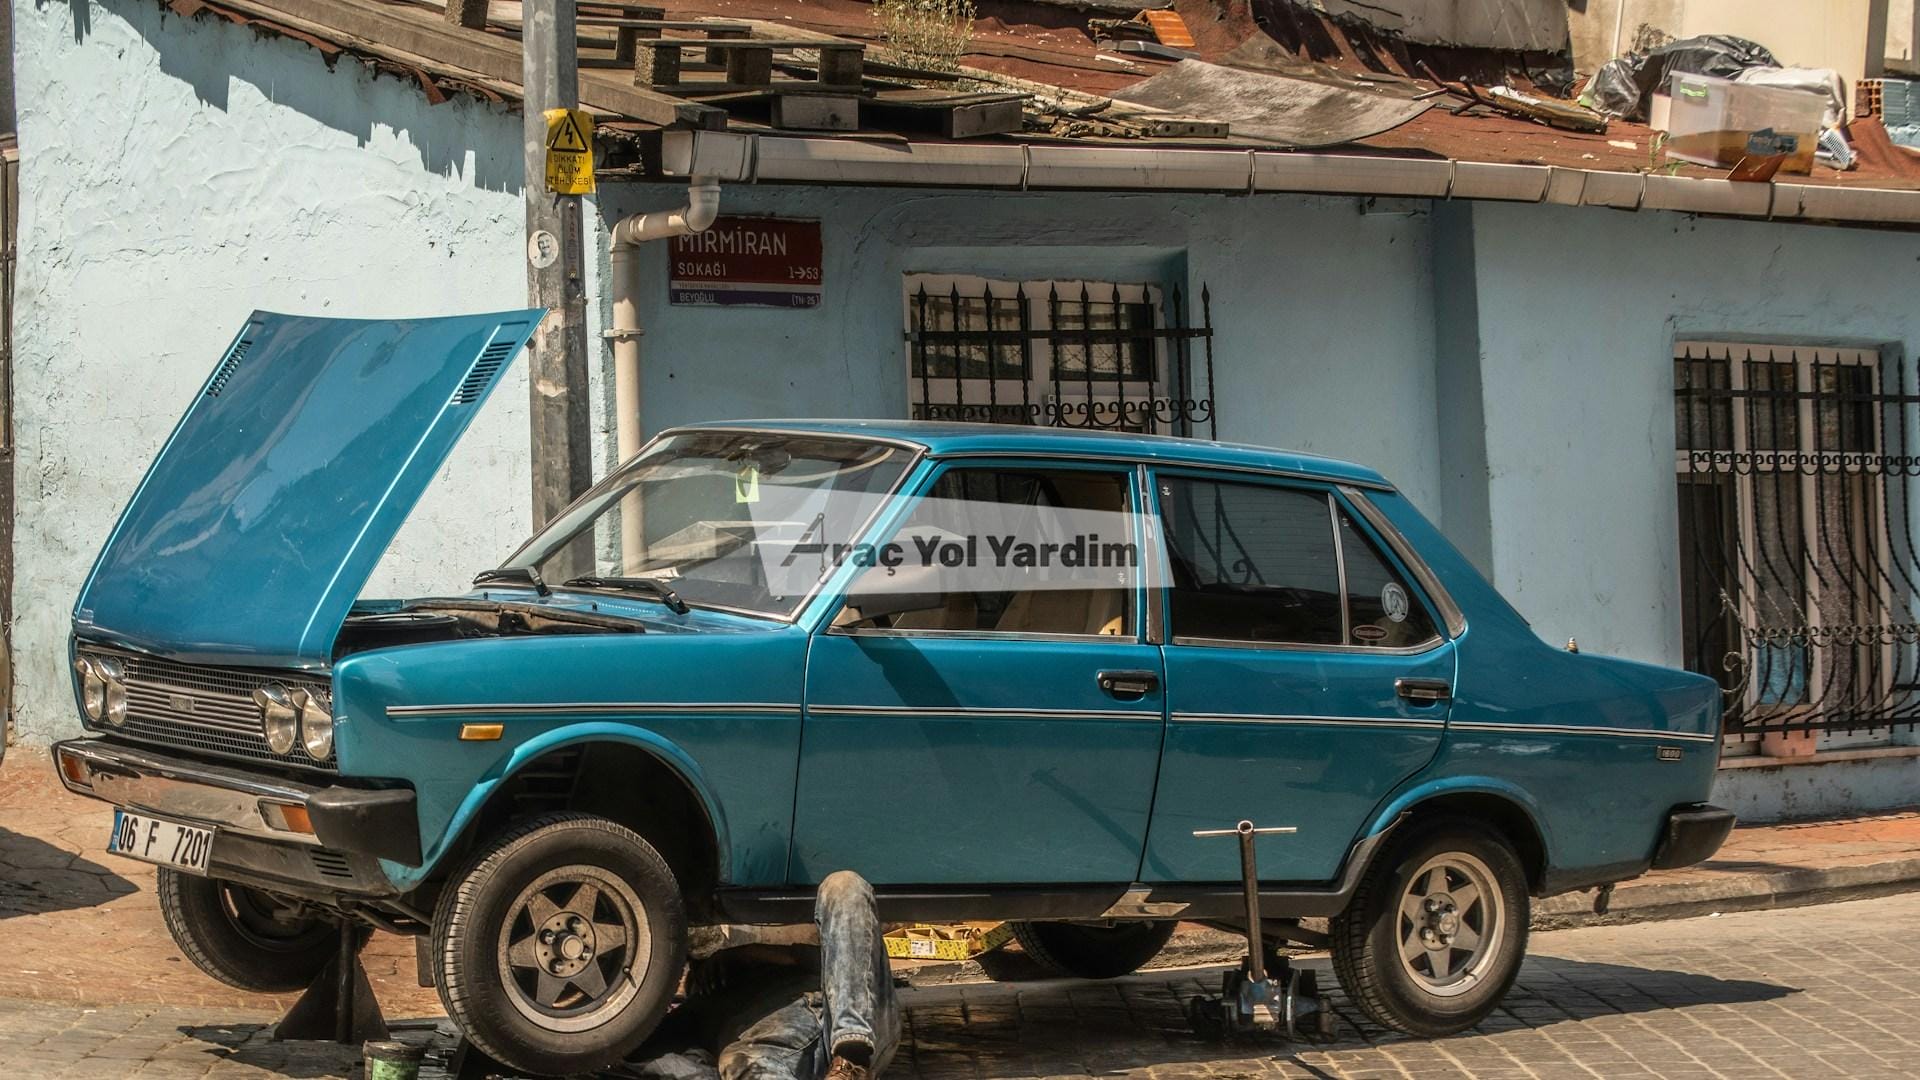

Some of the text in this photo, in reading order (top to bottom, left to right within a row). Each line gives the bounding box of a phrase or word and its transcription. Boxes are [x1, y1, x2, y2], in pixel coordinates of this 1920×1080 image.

[678, 261, 727, 277] SOKAĞI
[679, 291, 715, 303] BEYOĞLU
[118, 815, 211, 869] 06 F 7201
